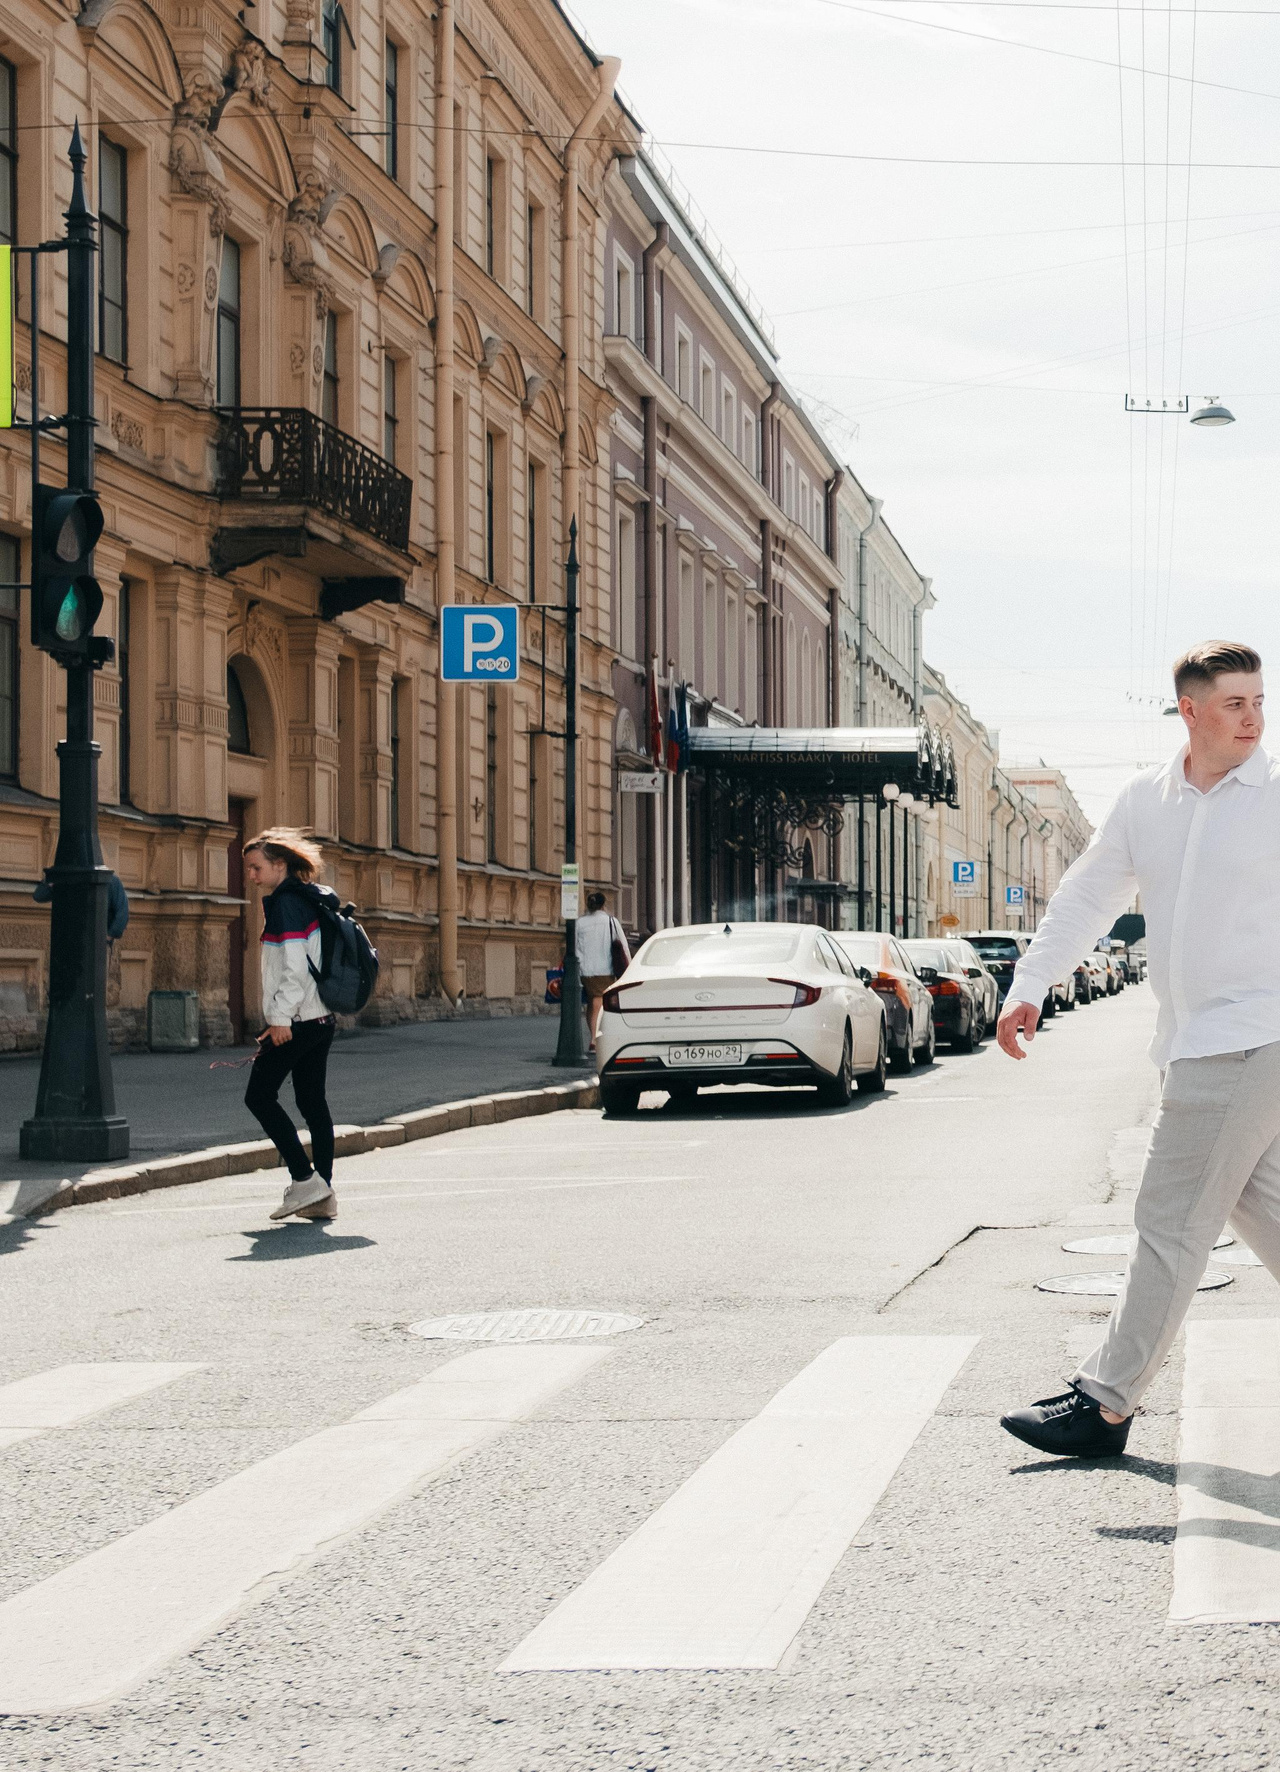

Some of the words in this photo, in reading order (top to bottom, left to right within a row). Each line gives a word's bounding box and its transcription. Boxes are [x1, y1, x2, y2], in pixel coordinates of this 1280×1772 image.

[464, 614, 504, 673] P
[497, 660, 509, 669] 20
[786, 753, 833, 764] ISAAKIY
[842, 753, 880, 764] HOTEL
[958, 863, 971, 882] P
[1010, 888, 1020, 902] P
[725, 1046, 737, 1055] 29
